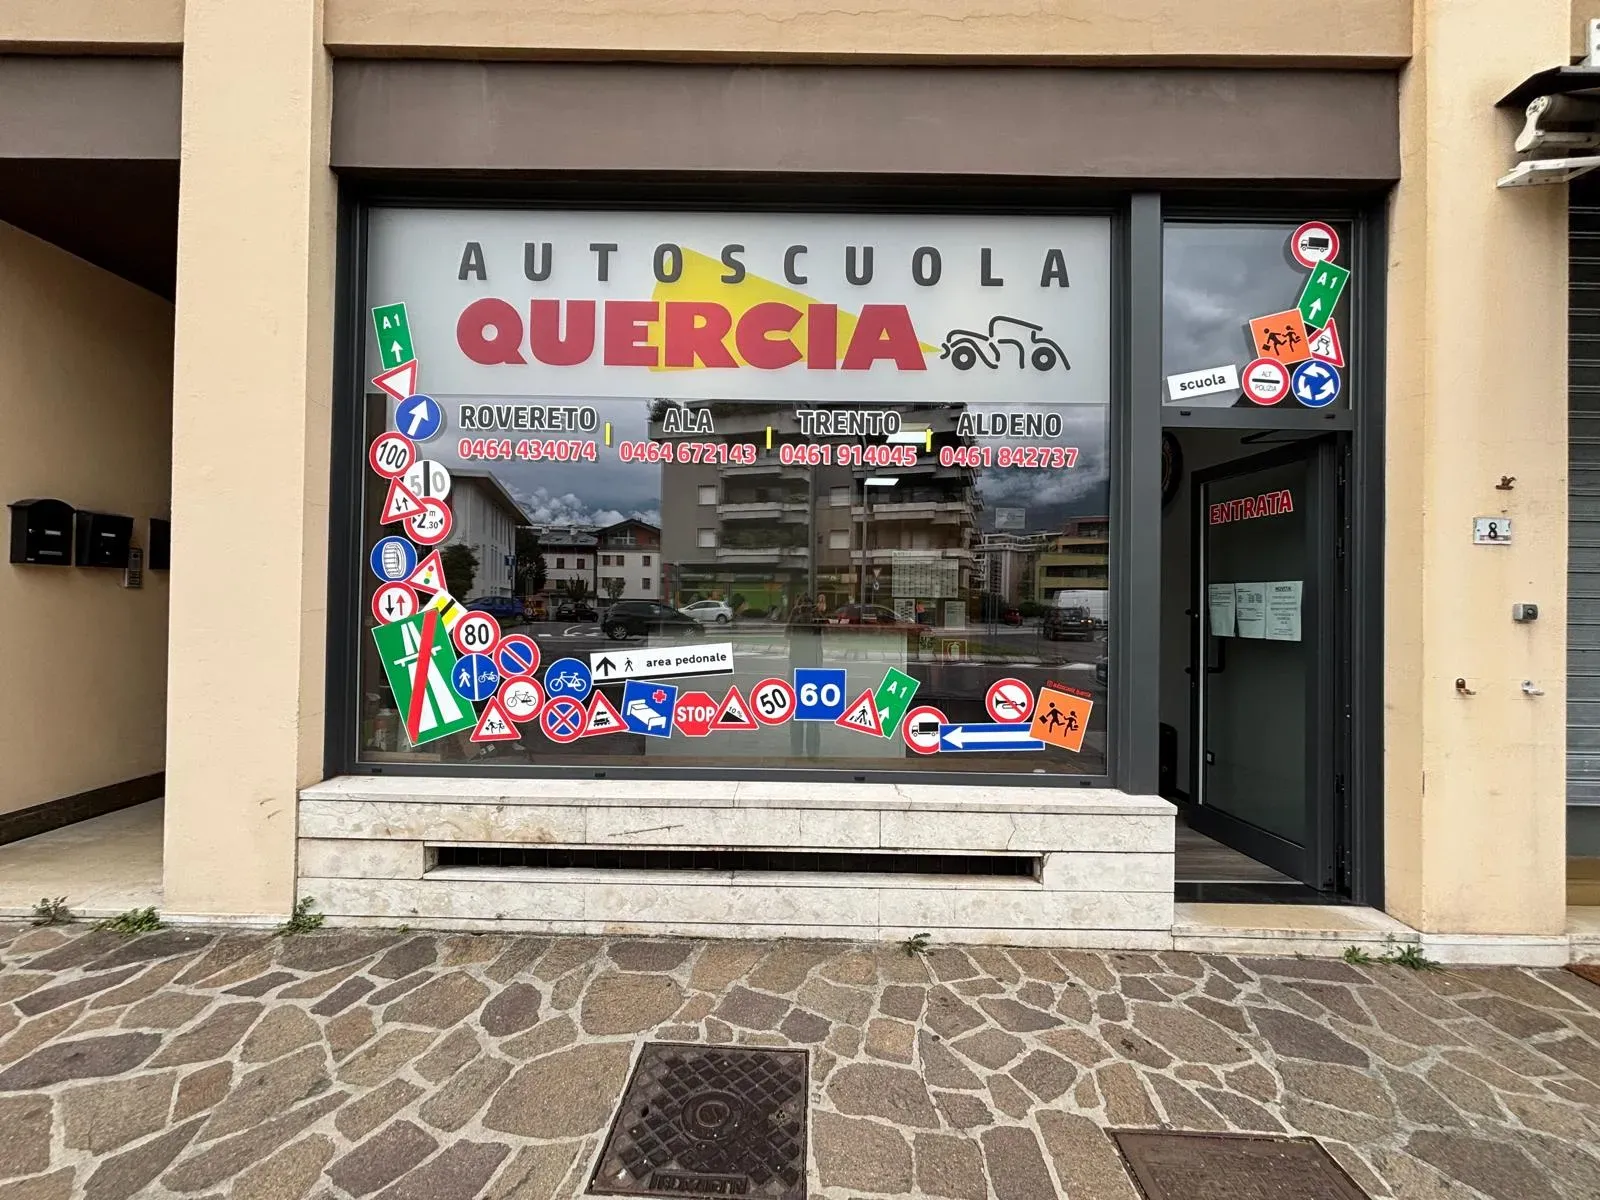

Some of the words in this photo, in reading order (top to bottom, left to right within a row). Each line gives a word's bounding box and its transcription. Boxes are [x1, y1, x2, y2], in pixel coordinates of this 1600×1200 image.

[457, 241, 1070, 288] AUTOSCUOLA
[456, 297, 928, 372] QUERCIA
[1179, 374, 1226, 391] scuola
[1261, 370, 1272, 378] ALT
[459, 405, 597, 432] ROVERETO
[662, 408, 715, 434] ALA
[796, 410, 902, 436] TRENTO
[956, 412, 1063, 438] ALDENO
[379, 441, 407, 469] 100
[457, 438, 512, 460] 0464
[515, 440, 597, 462] 434074
[619, 441, 674, 463] 0464
[676, 442, 757, 465] 672143
[779, 443, 832, 466] 0461
[837, 445, 918, 468] 914045
[939, 446, 993, 468] 0461
[997, 447, 1079, 469] 842737
[1209, 489, 1294, 525] ENTRATA
[1488, 521, 1498, 540] 8
[464, 623, 489, 646] 80
[646, 659, 672, 668] area
[675, 652, 727, 667] pedonale
[759, 688, 787, 715] 50
[800, 682, 841, 707] 60
[677, 706, 716, 722] STOP
